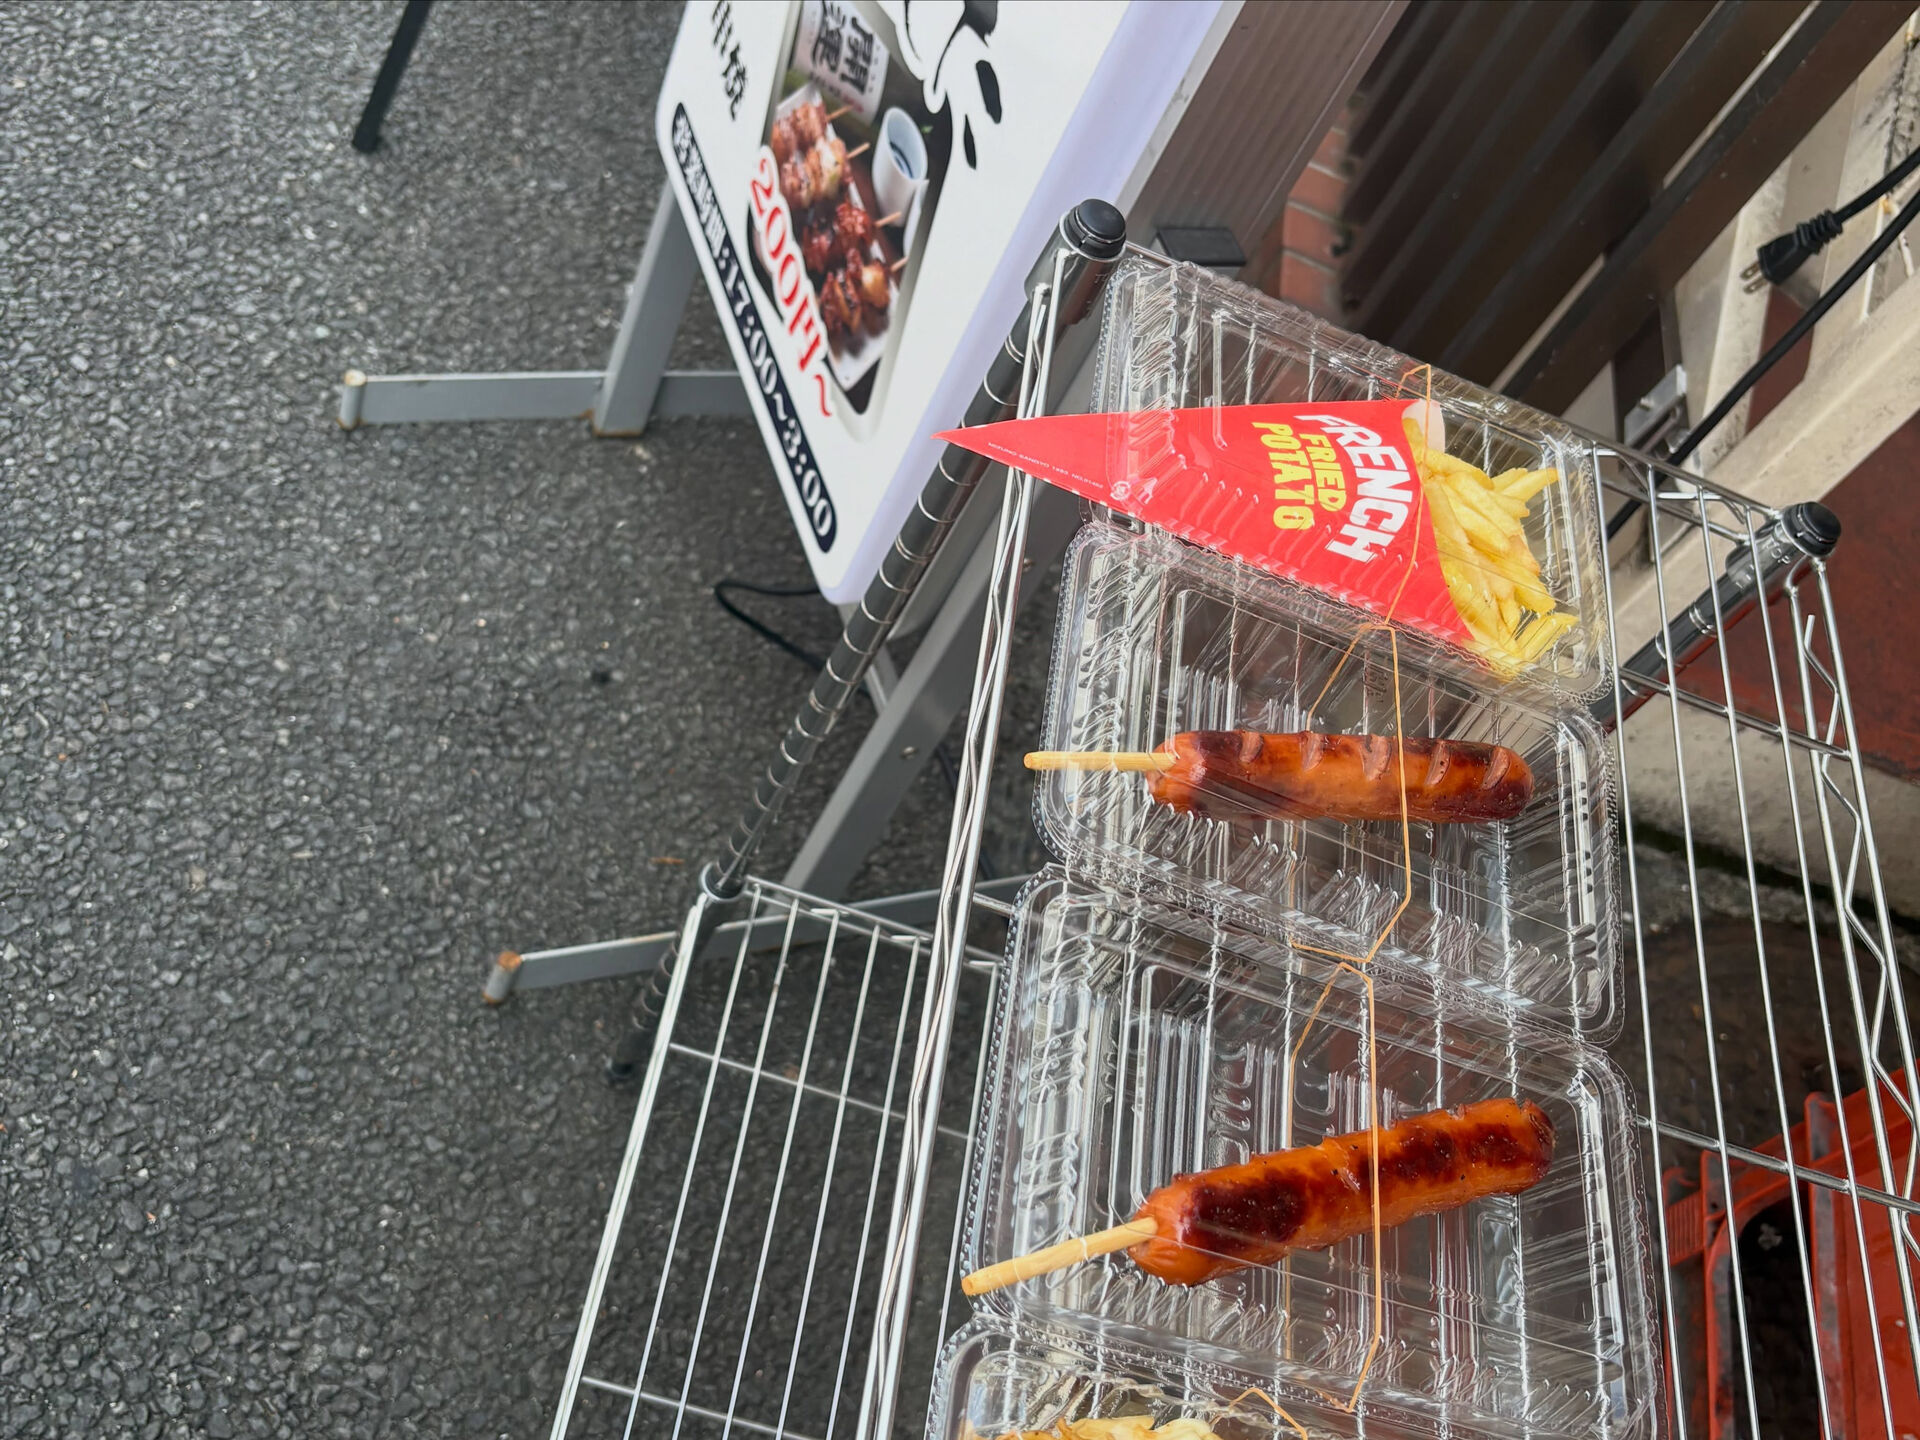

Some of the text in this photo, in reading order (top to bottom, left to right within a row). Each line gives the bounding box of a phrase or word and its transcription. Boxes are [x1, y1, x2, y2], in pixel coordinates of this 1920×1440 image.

[1252, 422, 1315, 530] POTATO
[1294, 415, 1413, 562] FRENCH
[1299, 433, 1347, 512] FRIED
